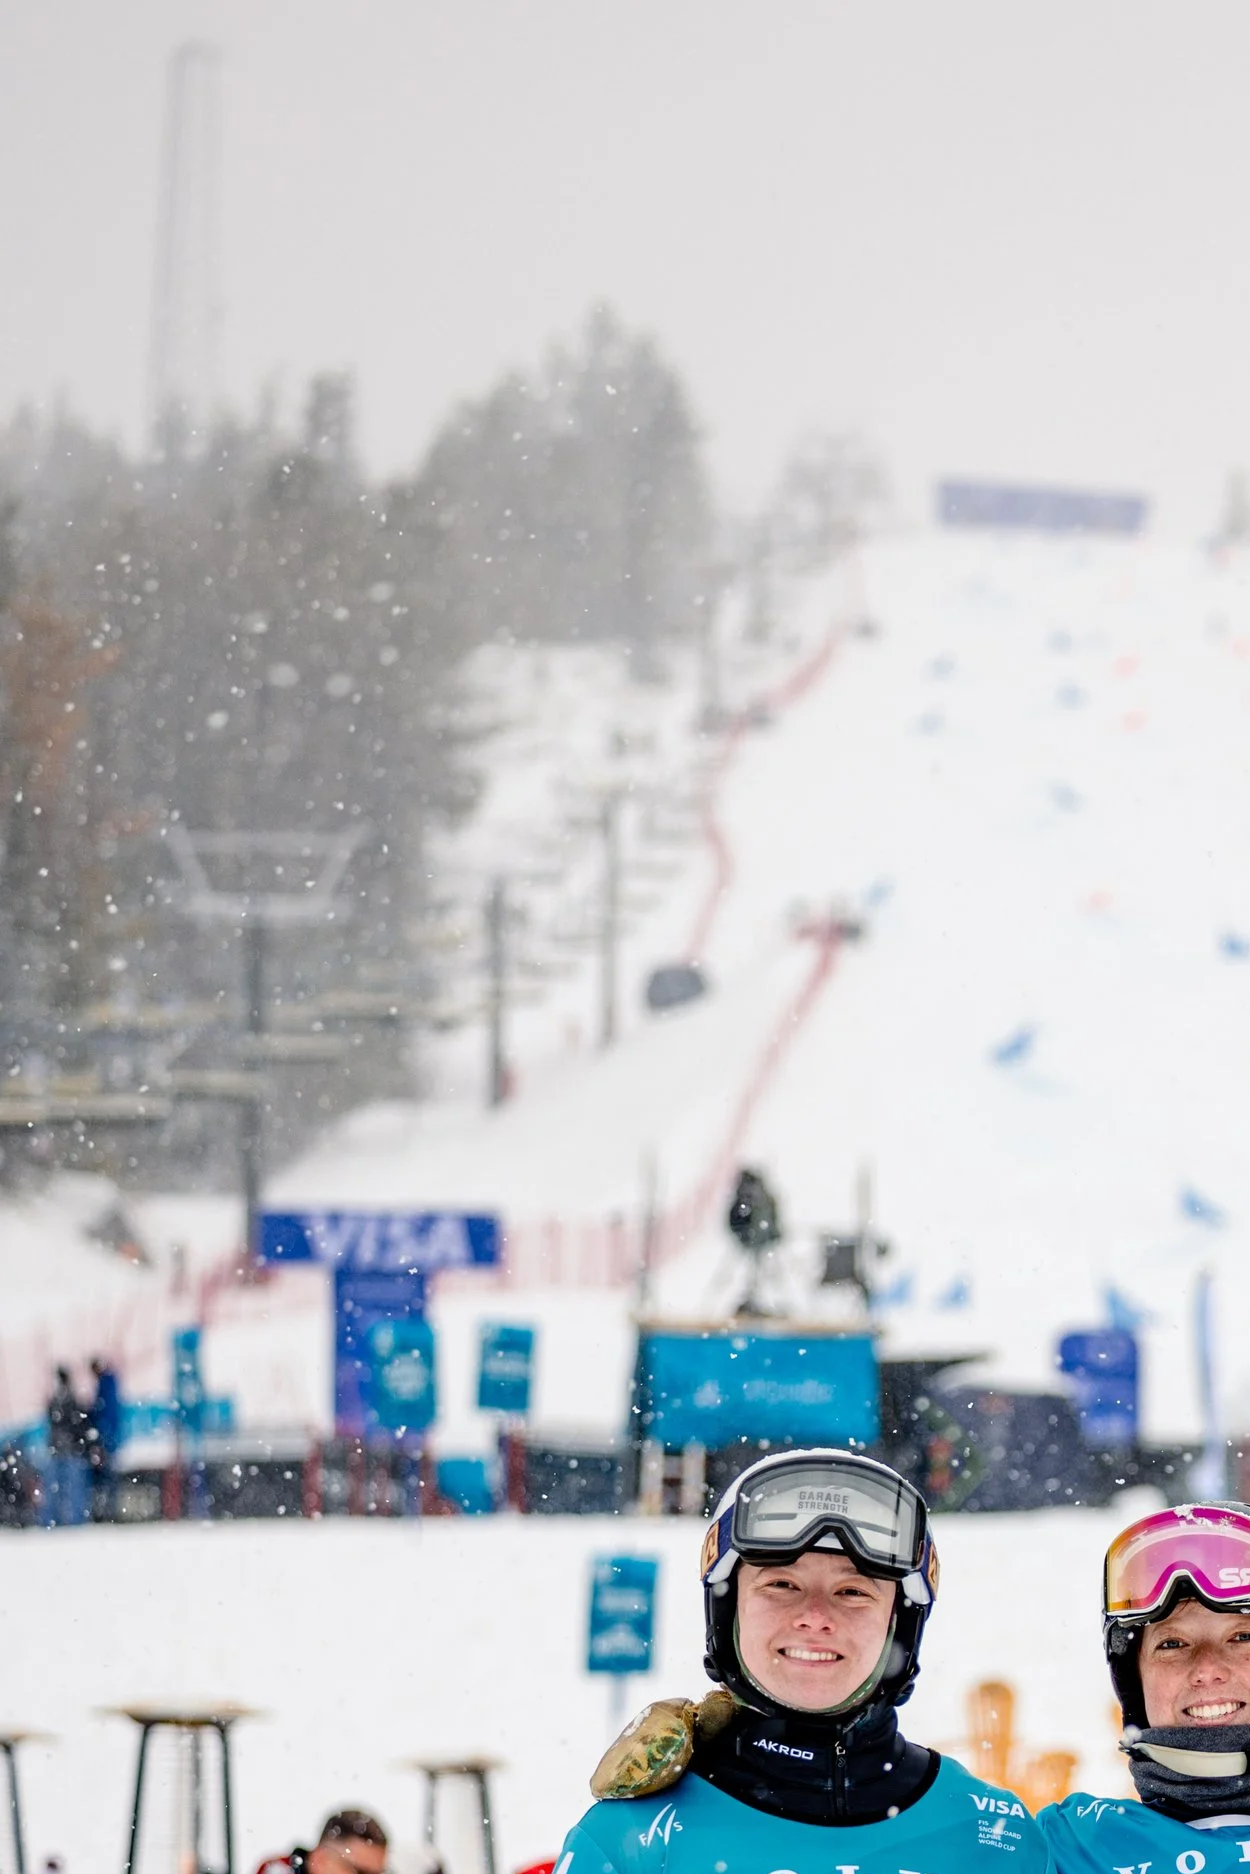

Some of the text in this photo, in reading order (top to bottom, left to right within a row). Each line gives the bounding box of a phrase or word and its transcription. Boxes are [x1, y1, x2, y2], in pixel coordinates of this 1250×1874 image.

[302, 1212, 473, 1268] VISA
[799, 1490, 850, 1505] GARAGE
[797, 1501, 849, 1514] STRENGTH
[968, 1793, 1025, 1819] VISA
[978, 1825, 1022, 1840] SNOOARD
[978, 1839, 1016, 1852] WORLD CUP
